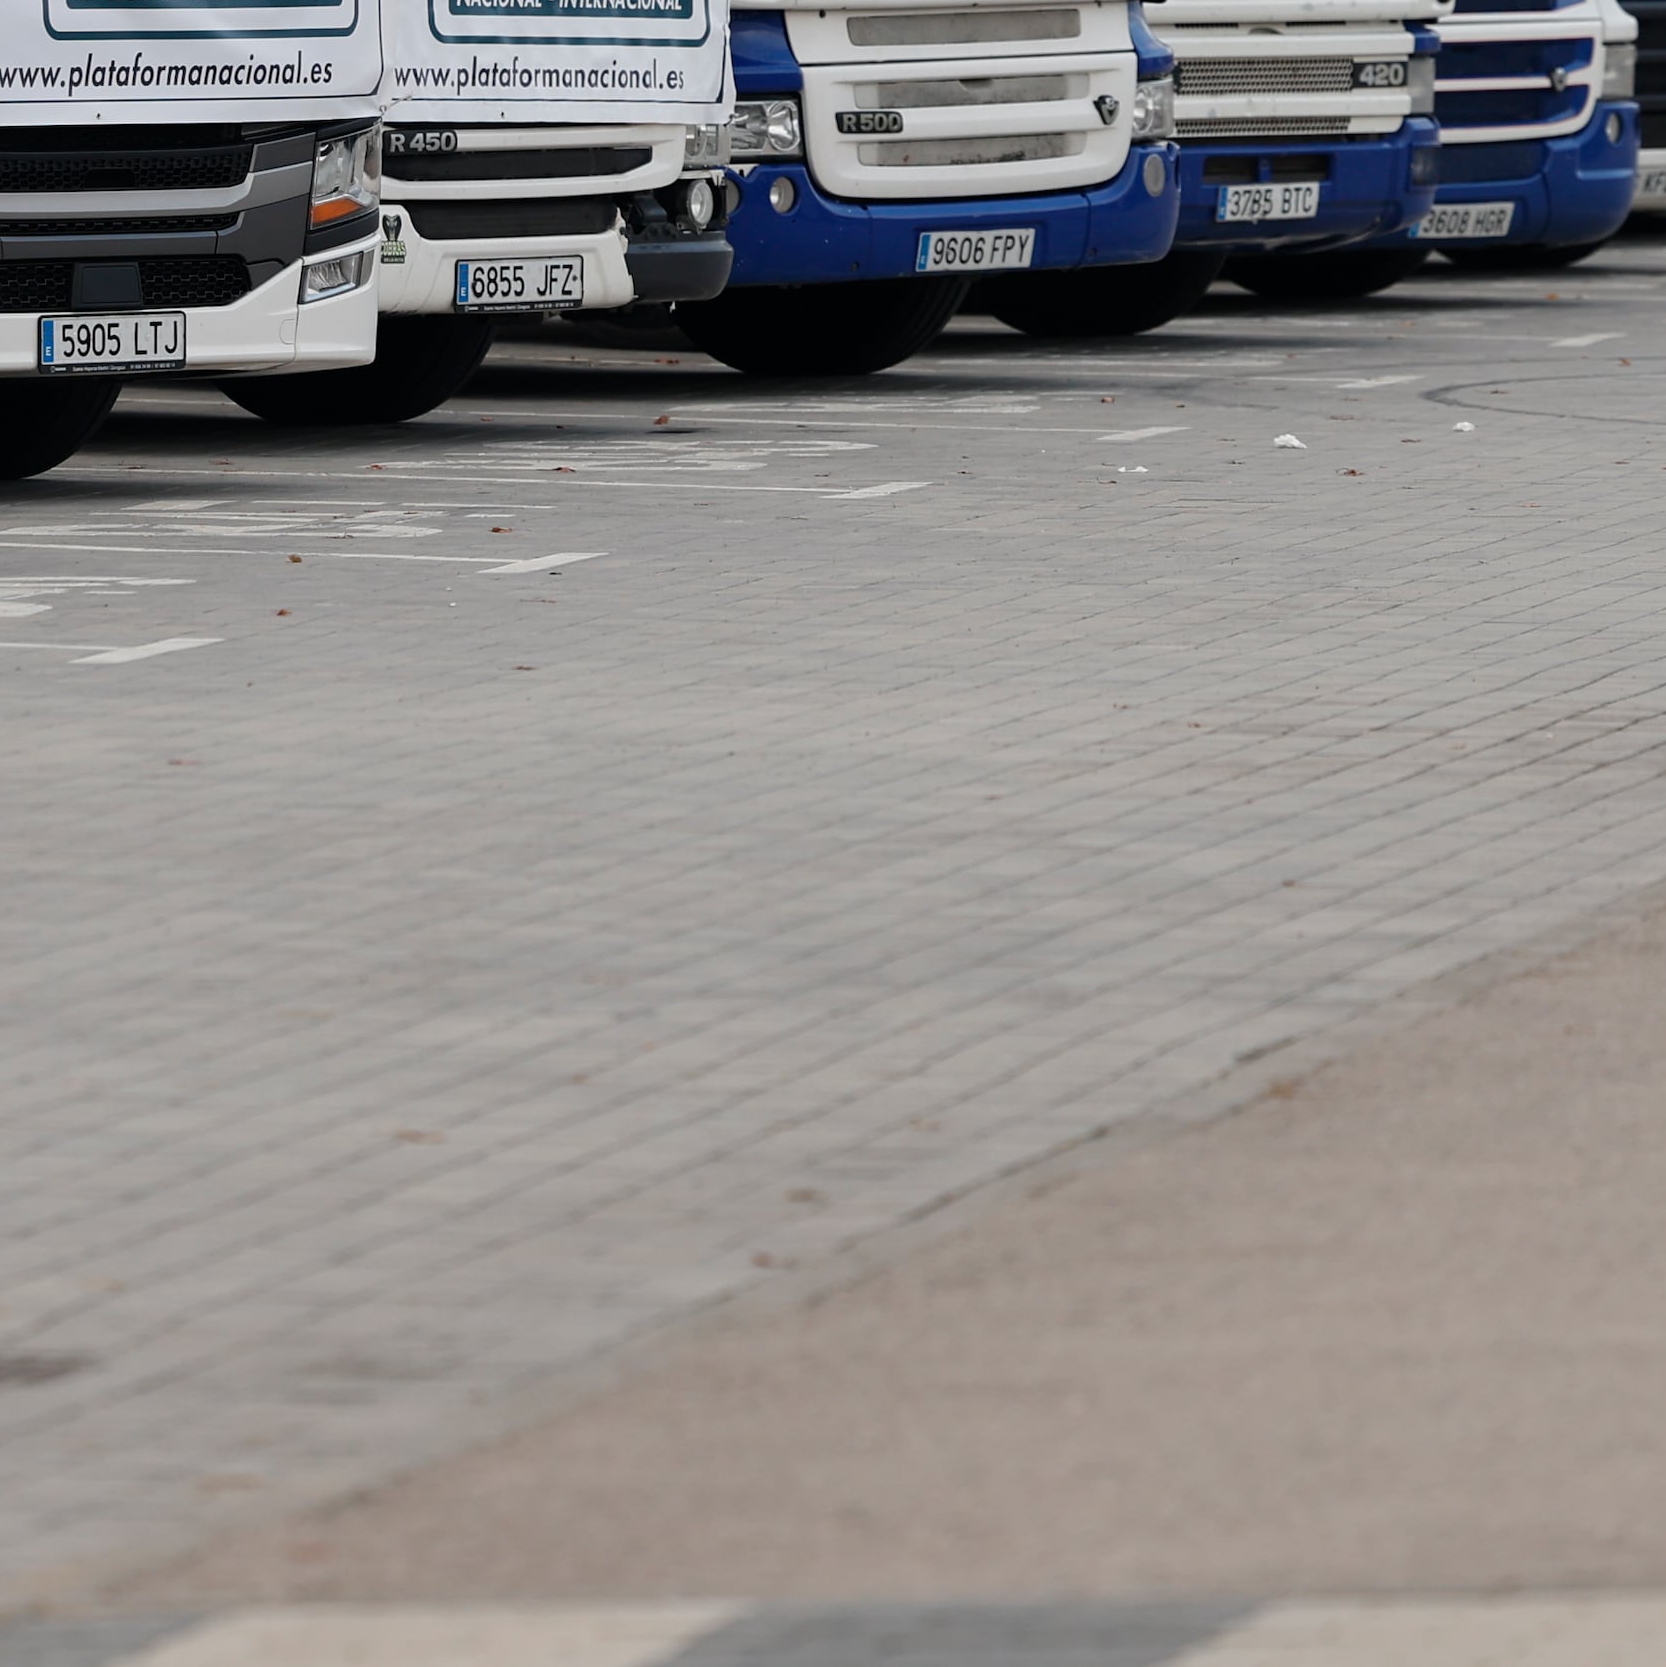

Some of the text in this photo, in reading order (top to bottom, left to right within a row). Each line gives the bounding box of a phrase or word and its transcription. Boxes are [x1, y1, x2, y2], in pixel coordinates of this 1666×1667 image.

[395, 57, 684, 94] www.plataformanacional.es
[1360, 64, 1404, 86] 420
[843, 113, 902, 132] R 500
[390, 131, 456, 152] R 450
[1281, 187, 1312, 214] BTC
[934, 235, 1029, 266] 9606 FPY
[473, 265, 525, 297] 6855
[537, 264, 573, 295] JFZ
[45, 320, 178, 358] E 5905 LTJ
